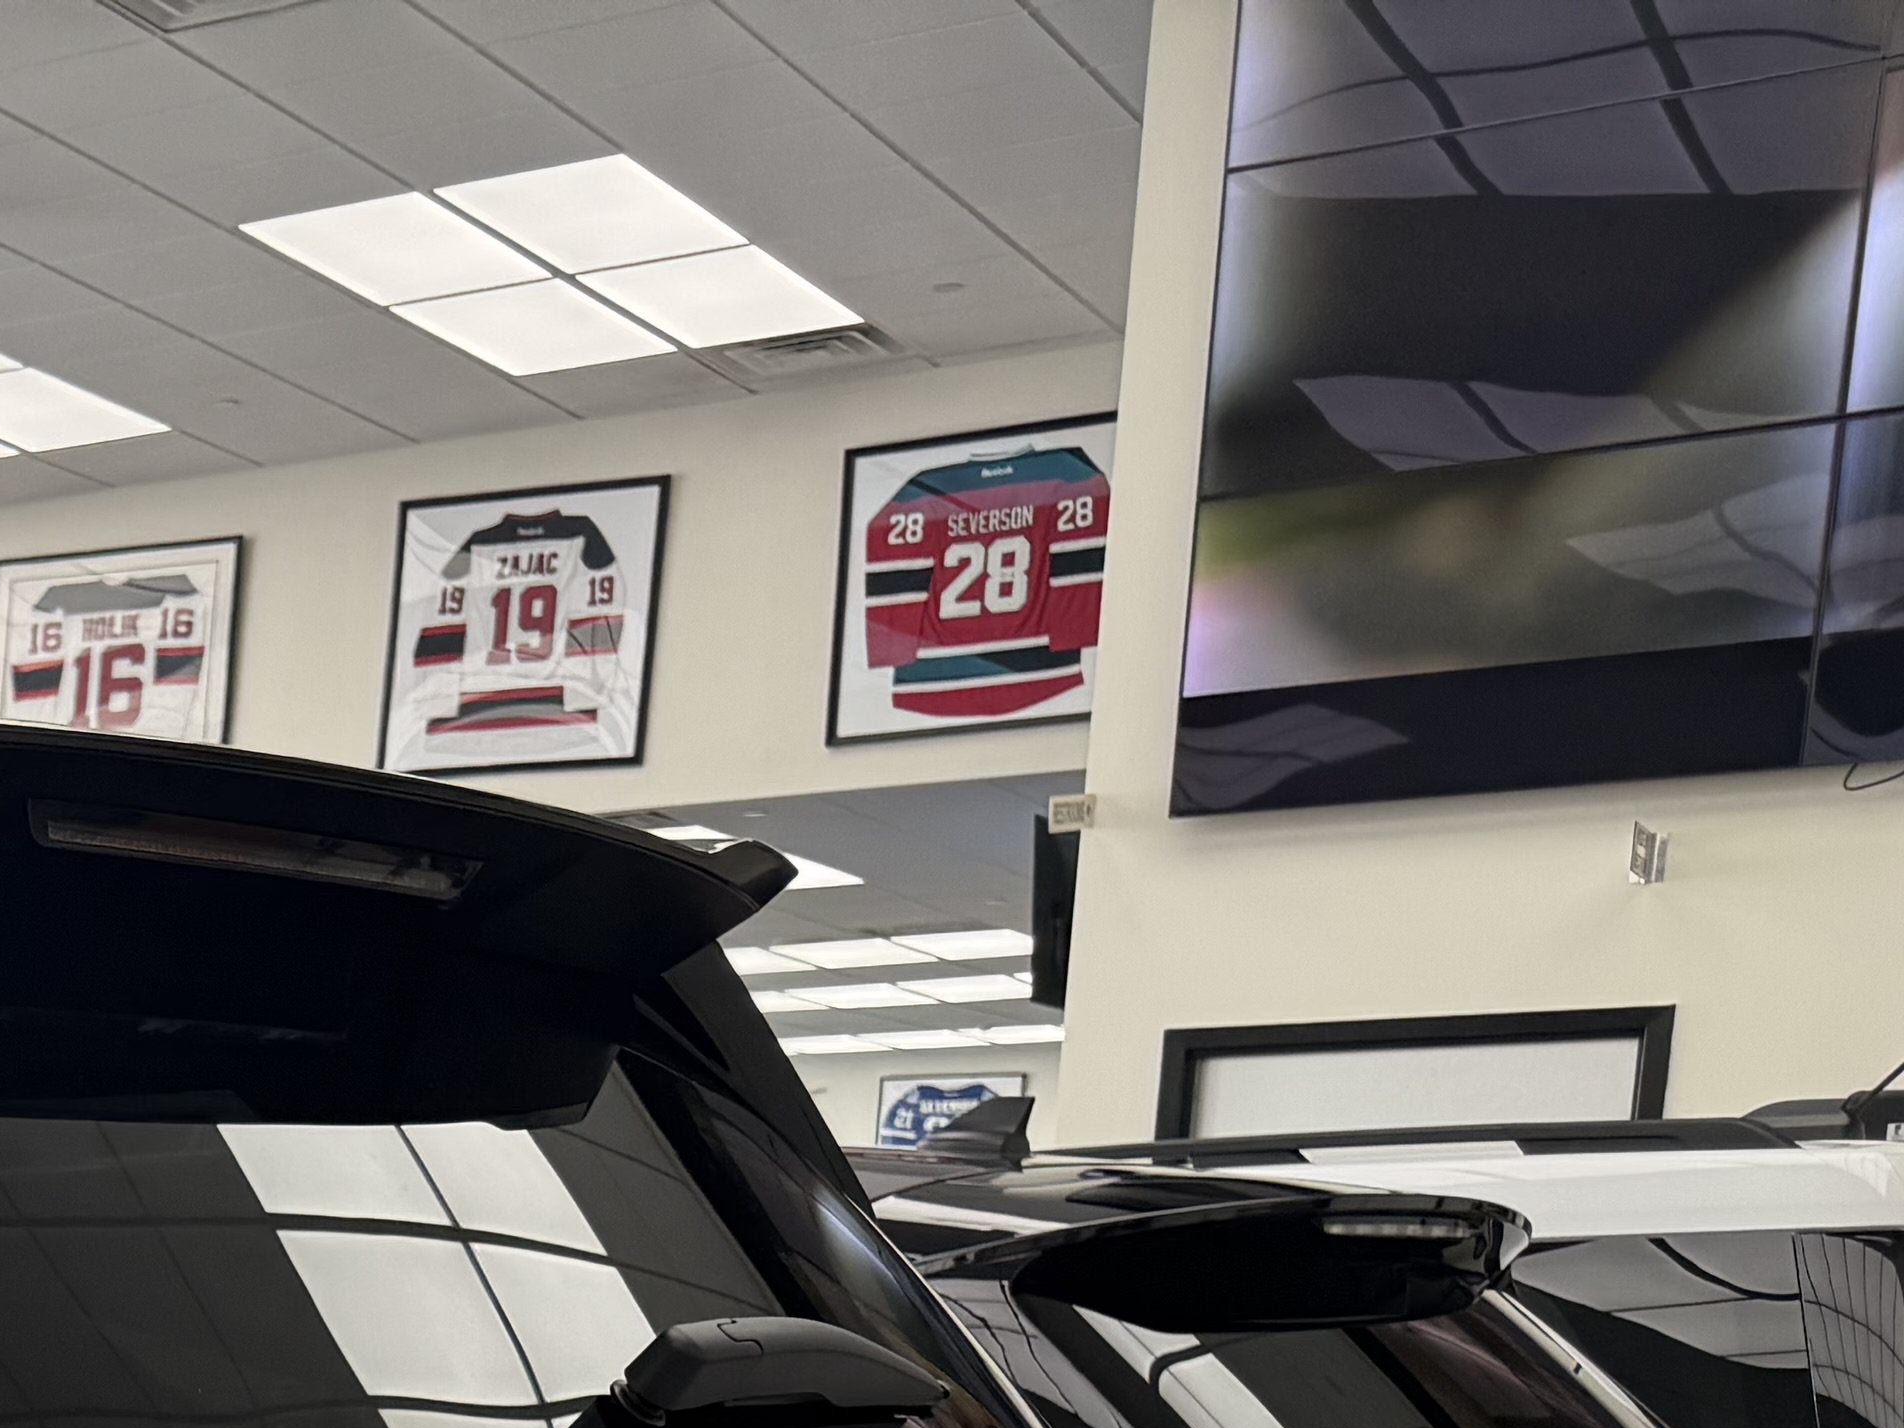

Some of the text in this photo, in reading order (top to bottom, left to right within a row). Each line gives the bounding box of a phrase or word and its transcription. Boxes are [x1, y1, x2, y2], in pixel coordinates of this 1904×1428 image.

[888, 512, 924, 545] 28
[948, 505, 1033, 536] SEVERSON
[1057, 496, 1093, 532] 28
[496, 552, 559, 579] ZAJAC
[939, 535, 1030, 619] 28
[438, 586, 465, 615] 19
[587, 576, 614, 607] 19
[30, 622, 63, 655] 16
[159, 608, 194, 640] 16
[485, 585, 558, 666] 19
[72, 643, 145, 727] 16
